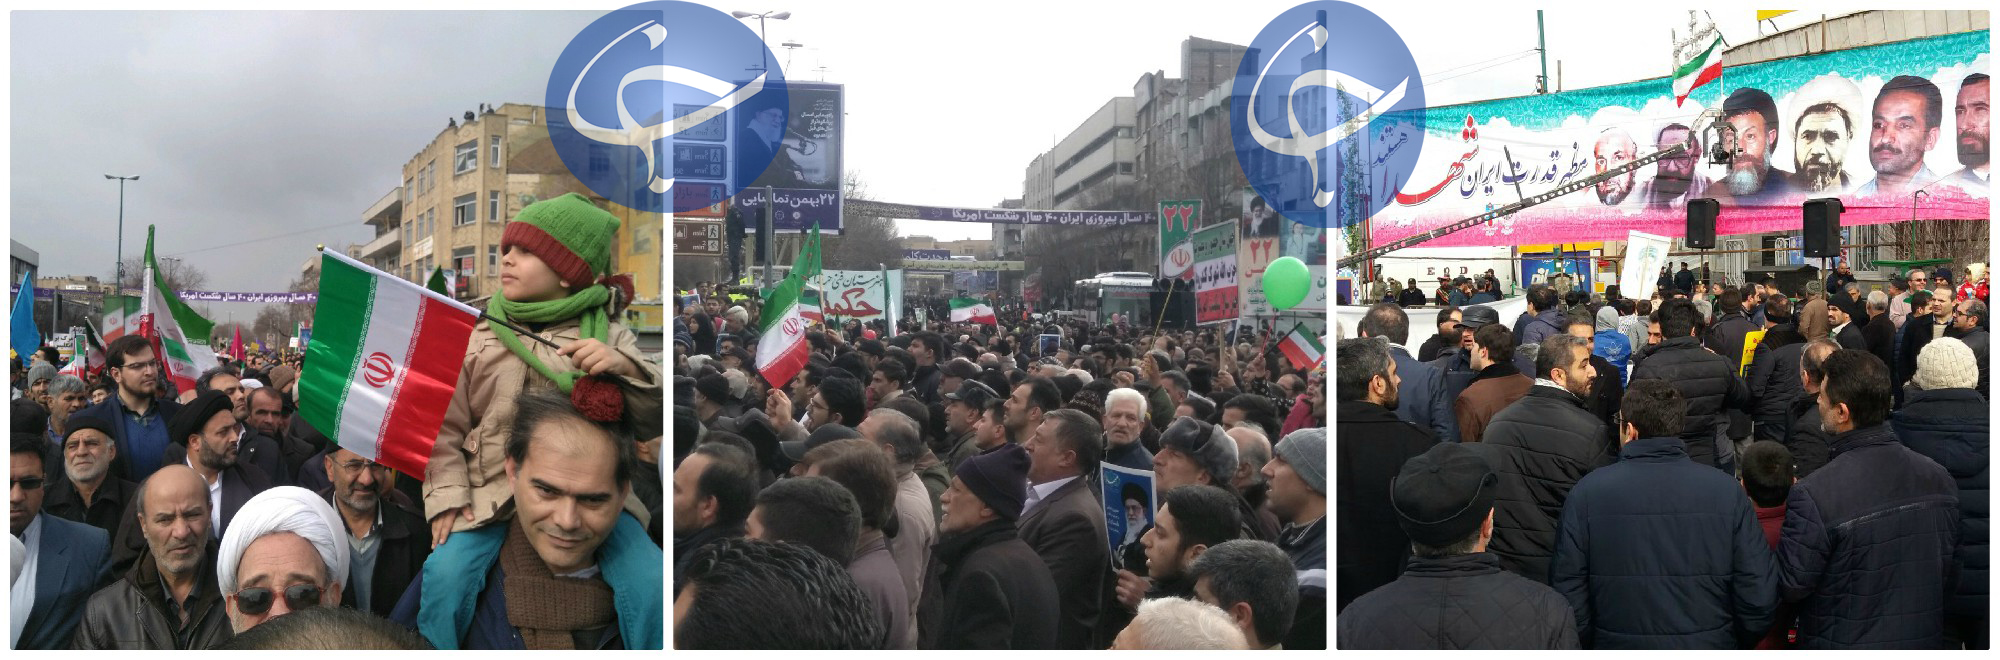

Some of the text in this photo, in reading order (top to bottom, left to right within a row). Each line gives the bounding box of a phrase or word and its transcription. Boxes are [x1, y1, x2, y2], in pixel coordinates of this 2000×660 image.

[1502, 150, 1561, 183] قدرت
[1557, 142, 1588, 187] مظهر
[1460, 160, 1502, 199] ایران
[984, 210, 1020, 221] شکست
[1022, 211, 1043, 224] سال
[1045, 212, 1057, 223] ۴۰
[1060, 213, 1083, 225] ایران
[1085, 213, 1117, 226] پیروزی
[1120, 213, 1142, 225] سال
[1144, 213, 1157, 223] ۴۰
[1163, 204, 1194, 232] ۲۲
[1250, 239, 1273, 264] ۲۲
[199, 292, 221, 300] شکست
[222, 293, 236, 301] سال
[247, 293, 264, 301] ایران
[265, 294, 288, 302] پیروزی
[288, 293, 306, 302] سال
